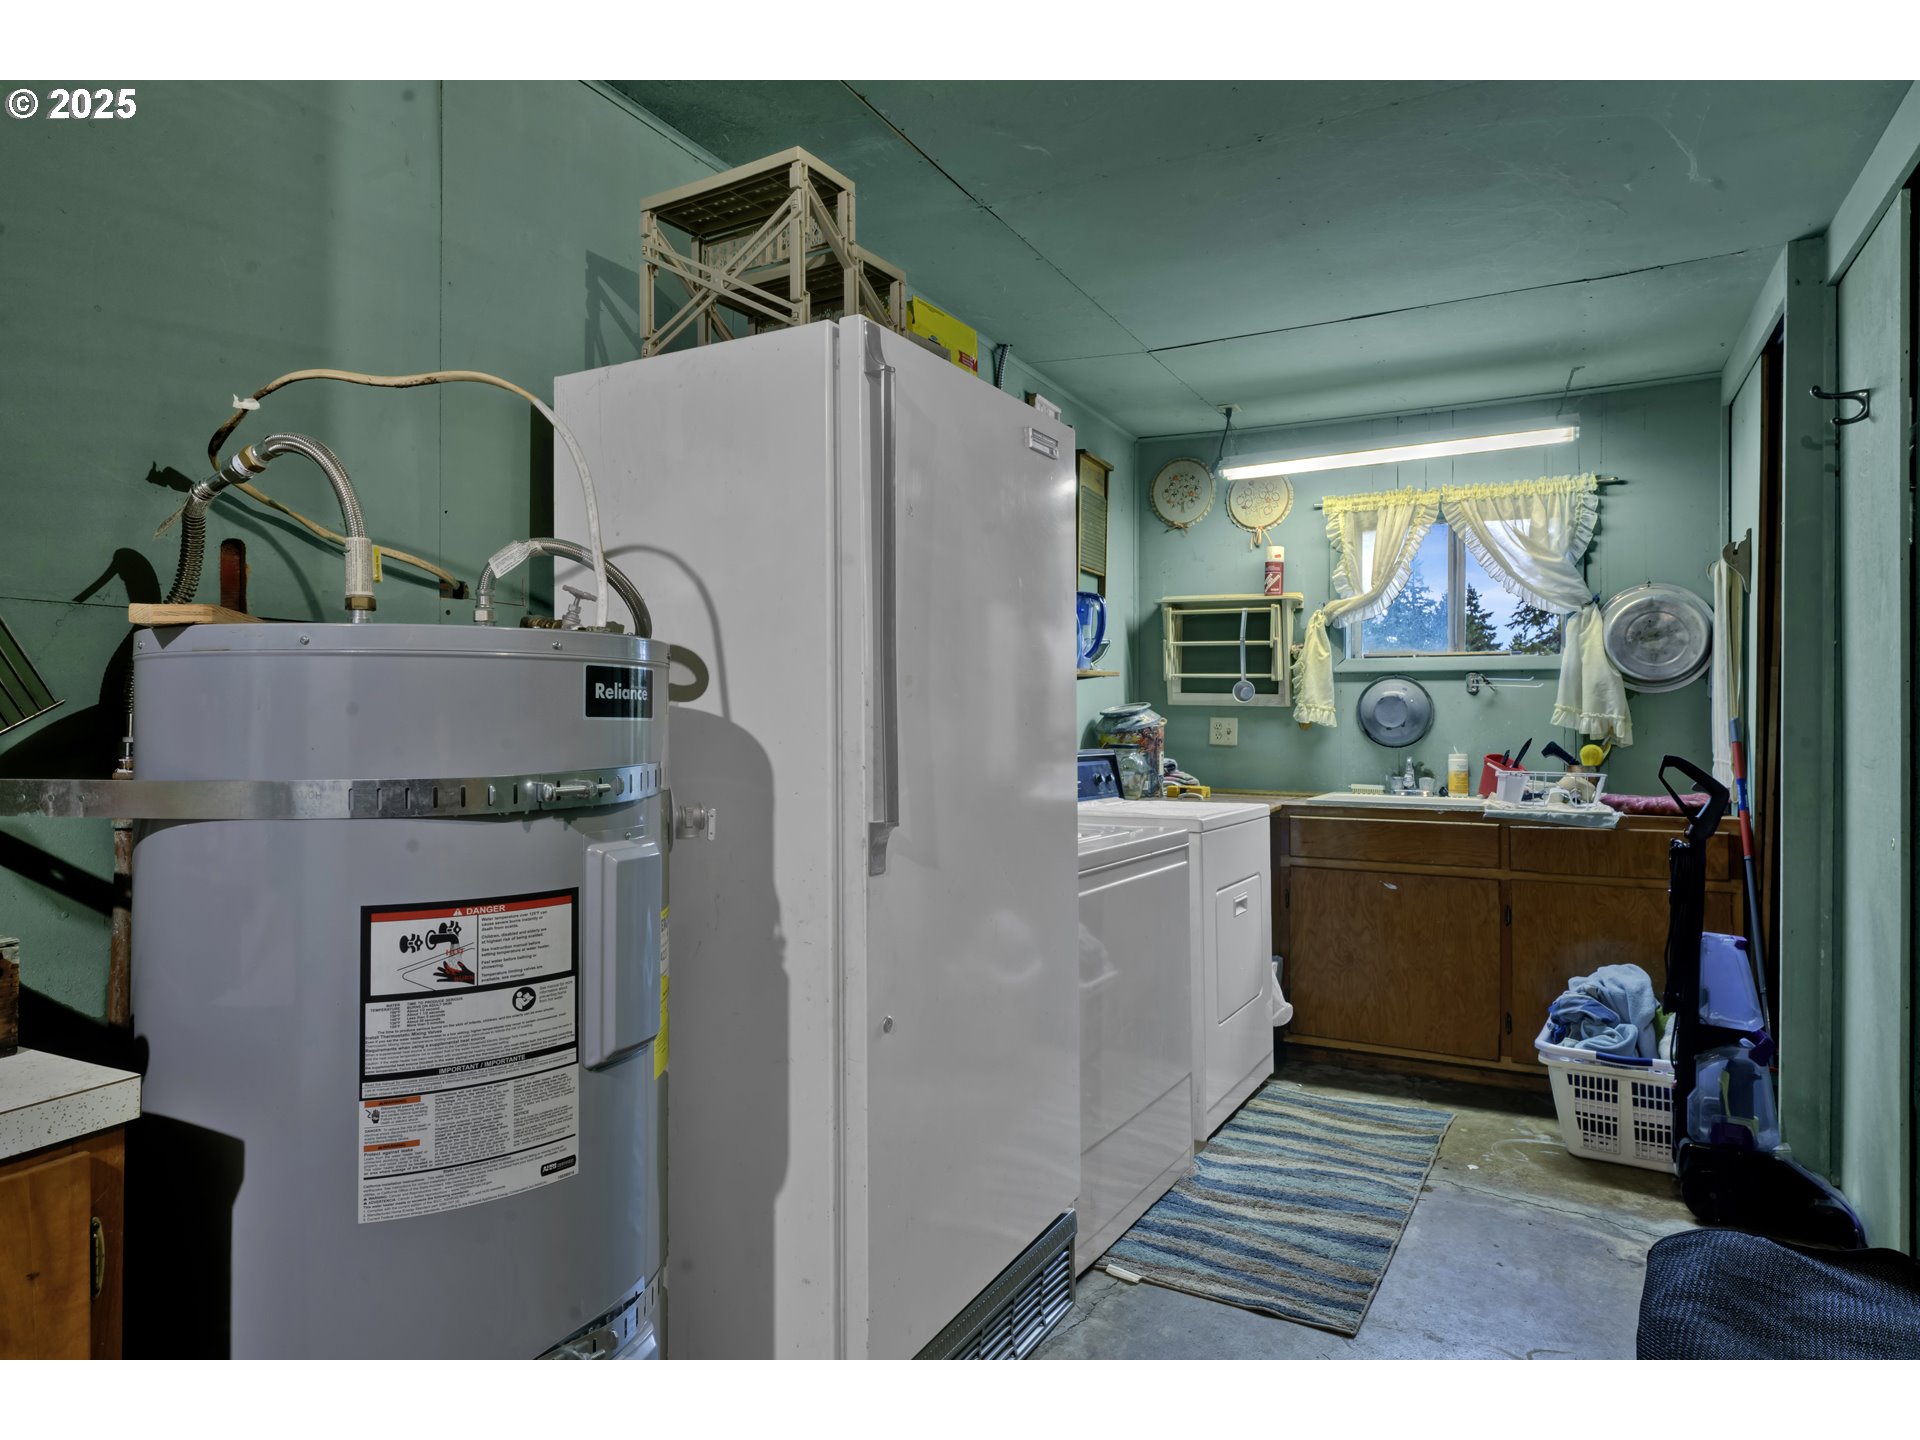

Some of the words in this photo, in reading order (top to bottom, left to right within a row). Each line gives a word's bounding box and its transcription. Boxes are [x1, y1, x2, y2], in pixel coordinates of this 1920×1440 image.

[595, 682, 648, 700] Reliance
[466, 905, 506, 914] DANGER
[439, 1063, 479, 1074] IMPORTANT
[484, 1054, 526, 1067] IMPORTANTE
